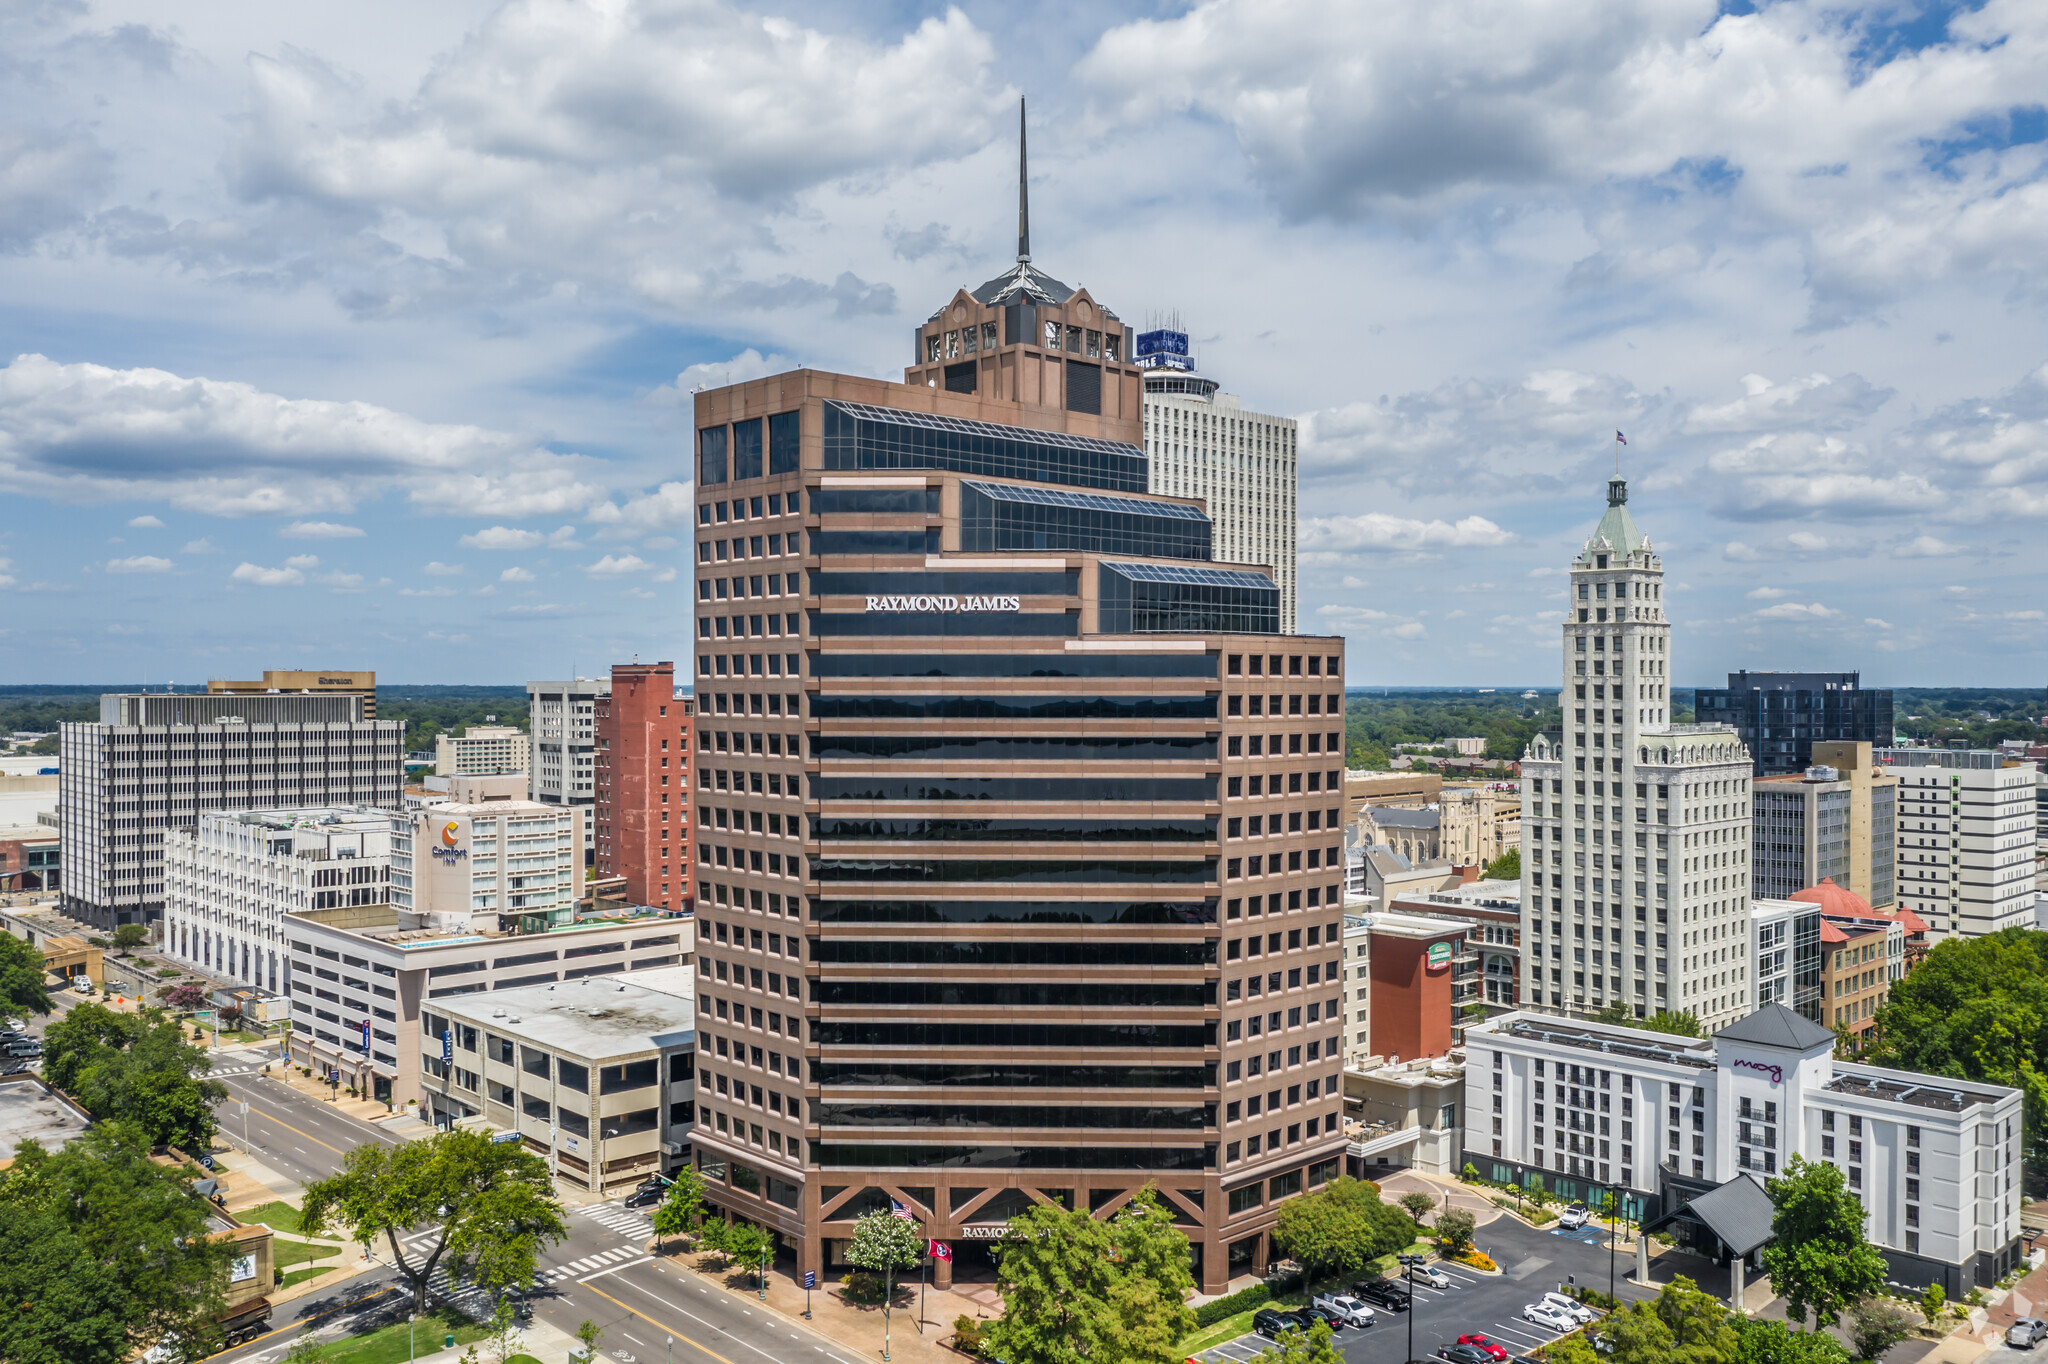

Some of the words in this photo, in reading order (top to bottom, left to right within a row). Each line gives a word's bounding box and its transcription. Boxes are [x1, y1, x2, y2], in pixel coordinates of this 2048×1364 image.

[865, 596, 958, 611] RAYMOND
[960, 596, 1020, 611] JAMES
[318, 677, 352, 685] Sheraton
[432, 846, 467, 857] Comfort
[1734, 1059, 1782, 1083] moxy
